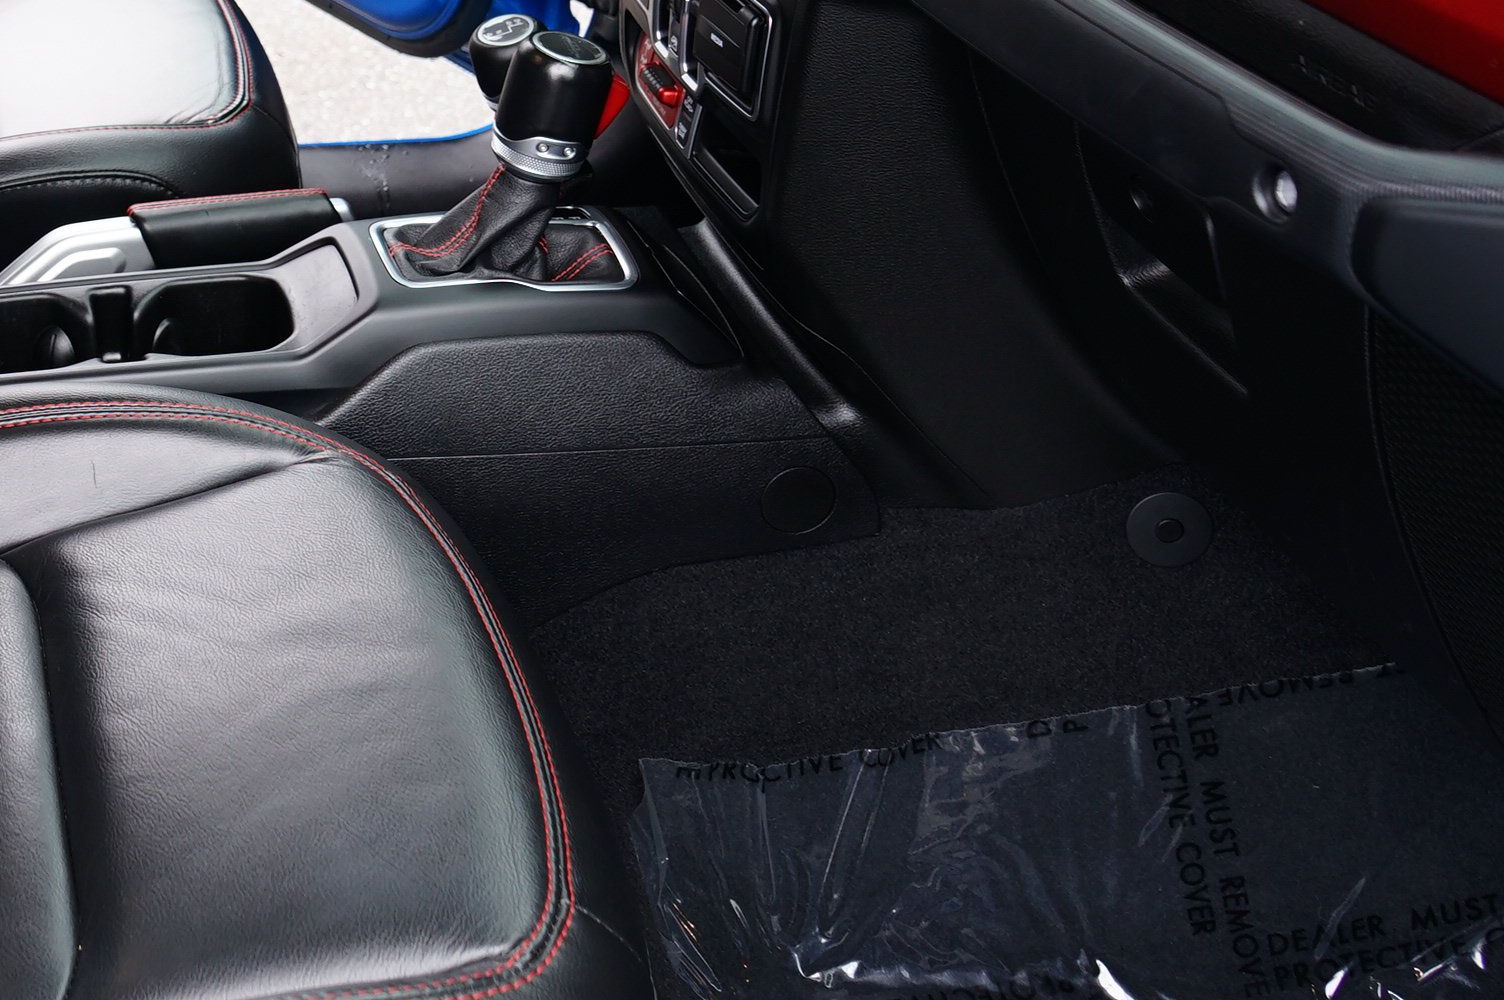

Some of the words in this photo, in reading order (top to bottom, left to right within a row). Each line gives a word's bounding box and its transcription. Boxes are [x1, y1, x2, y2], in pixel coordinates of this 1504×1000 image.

[1200, 780, 1242, 858] MUST
[1174, 840, 1216, 937] COVER
[1267, 914, 1386, 958] DEALER
[1409, 893, 1504, 931] MUST
[1218, 874, 1271, 1000] REMOVE
[1273, 936, 1465, 992] PROTECTIVE
